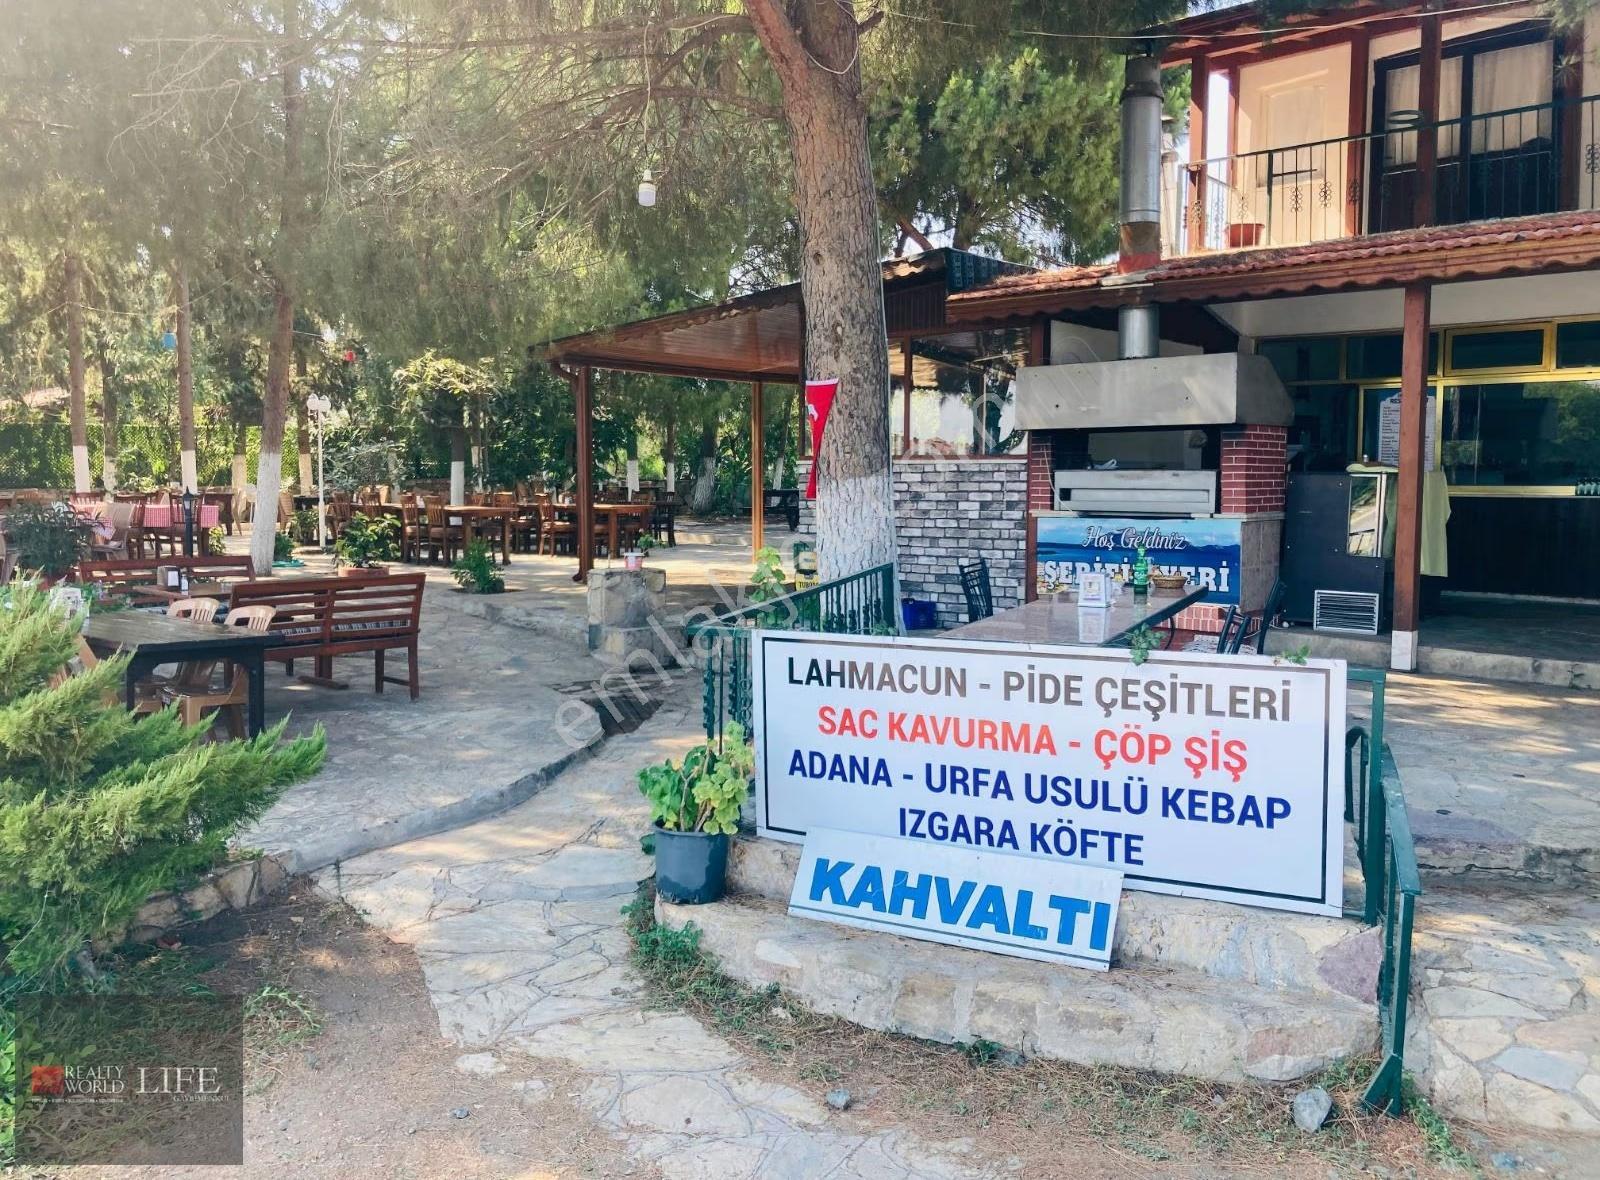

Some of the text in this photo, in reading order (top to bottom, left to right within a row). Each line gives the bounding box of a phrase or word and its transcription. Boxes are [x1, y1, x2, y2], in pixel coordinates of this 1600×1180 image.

[1082, 526, 1188, 550] Hoş Geldiniz
[1044, 556, 1155, 589] ŞERİFİ
[1158, 560, 1230, 592] YERİ
[788, 656, 967, 697] LAHMACUN
[1004, 664, 1083, 706] PİDE
[1096, 672, 1290, 722] ÇEŞİTLERİ
[818, 705, 878, 739] SAC
[888, 712, 1057, 756] KAVURMA
[1094, 727, 1171, 770] ÇÖP
[1184, 730, 1247, 783] ŞİŞ
[788, 748, 1292, 830] ADANA - URFA USULÜ KEBAP
[899, 807, 1144, 867] IZGARA KÖFTE
[808, 857, 1111, 952] KAHVALTI
